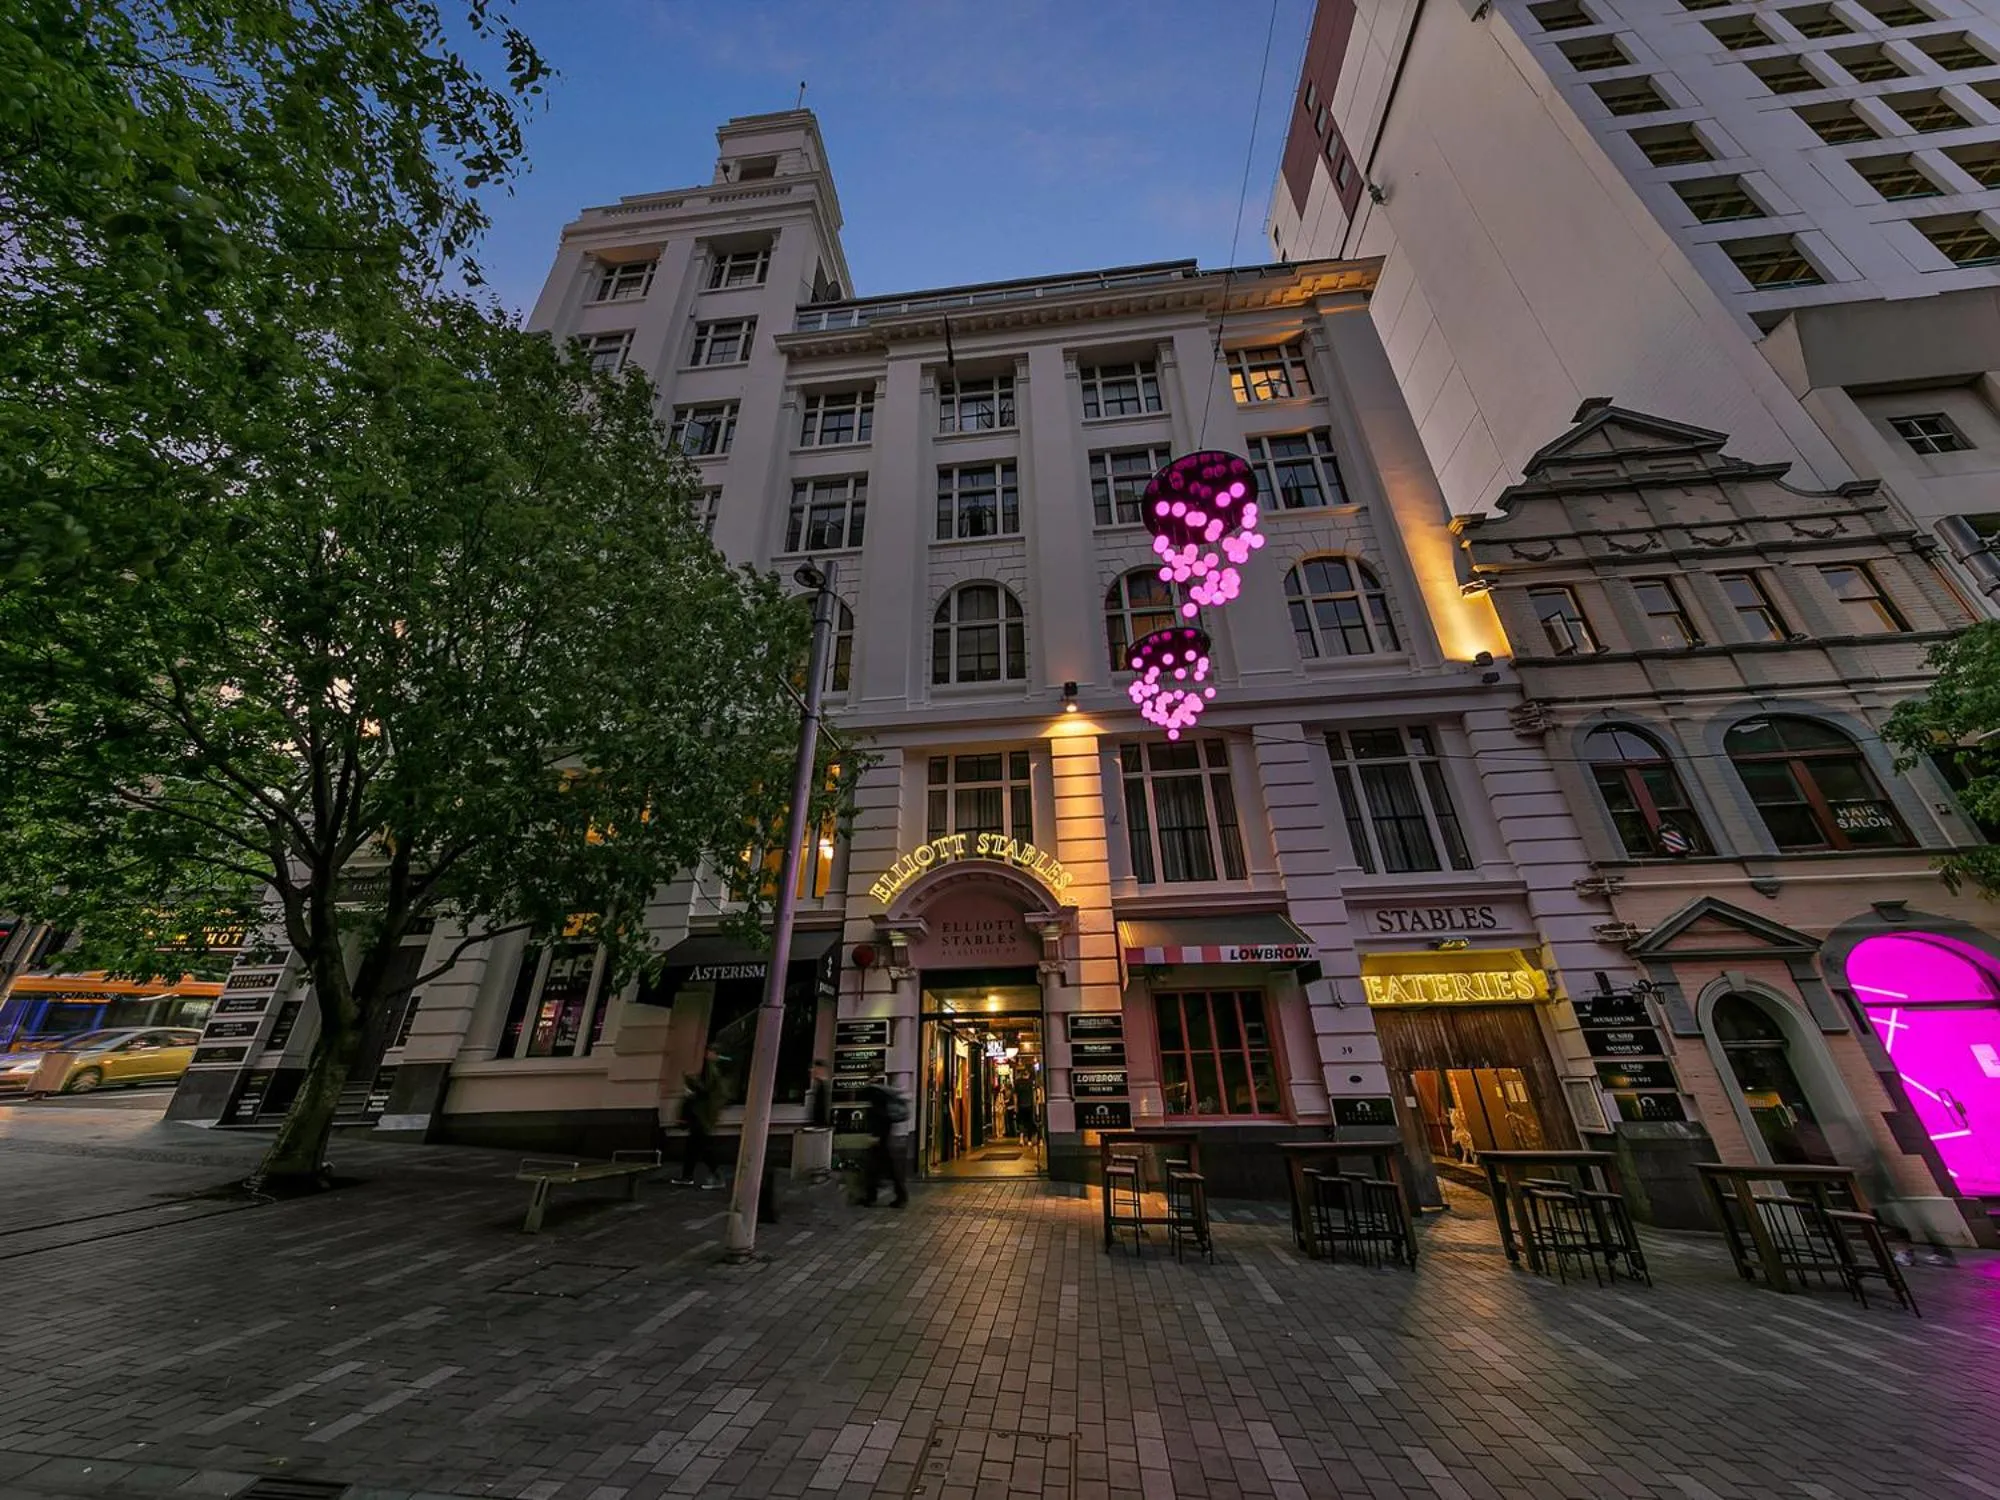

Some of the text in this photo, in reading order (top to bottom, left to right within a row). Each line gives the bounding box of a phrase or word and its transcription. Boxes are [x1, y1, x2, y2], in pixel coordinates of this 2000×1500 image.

[1836, 806, 1879, 818] HAIR
[1836, 815, 1893, 829] SALON
[869, 833, 1073, 904] ELLIOTT STABLES
[942, 920, 1015, 932] ELLIOTT
[1376, 907, 1497, 932] STABLES
[942, 934, 1016, 946] STABLES
[688, 964, 766, 981] ASTERISM
[1361, 971, 1536, 1004] EATERIES
